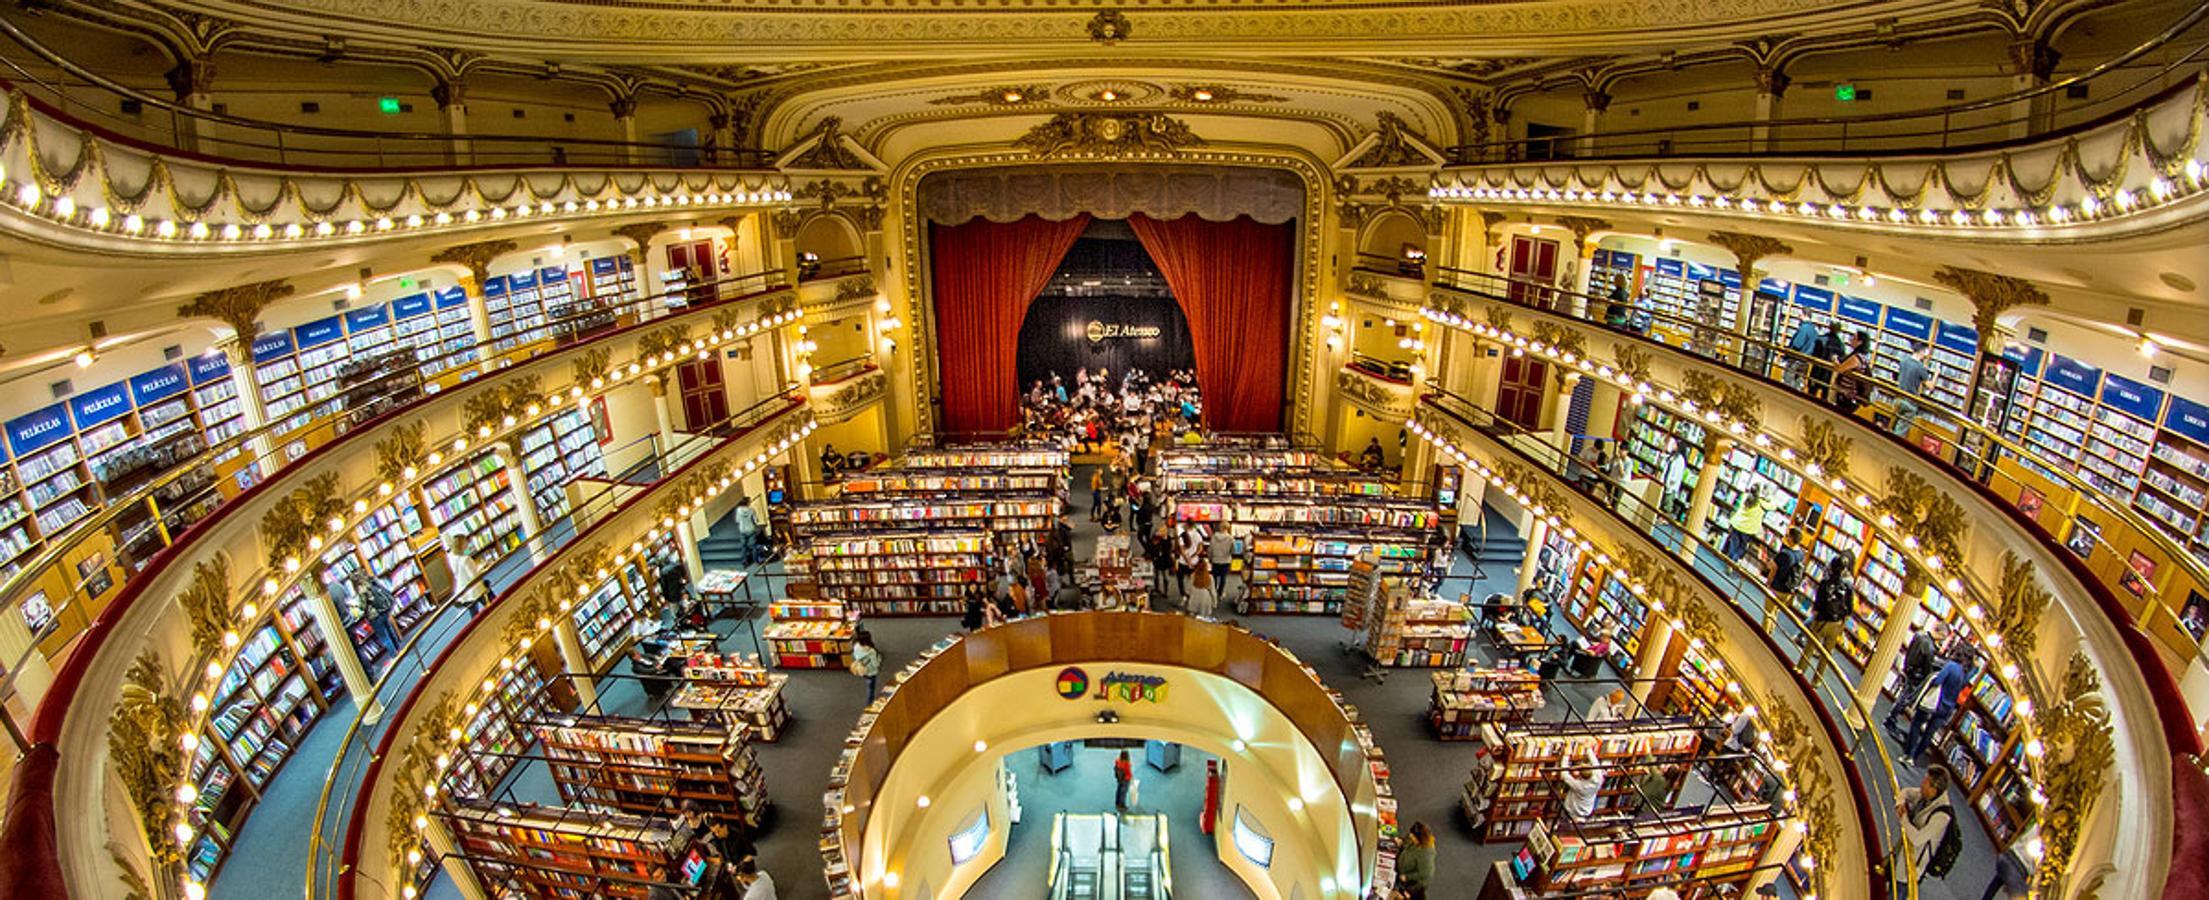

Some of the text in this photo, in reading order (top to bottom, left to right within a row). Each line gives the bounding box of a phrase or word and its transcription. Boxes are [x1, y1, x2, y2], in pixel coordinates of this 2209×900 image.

[1104, 324, 1160, 337] El Ateneo
[18, 417, 62, 441] PELÍCULAS
